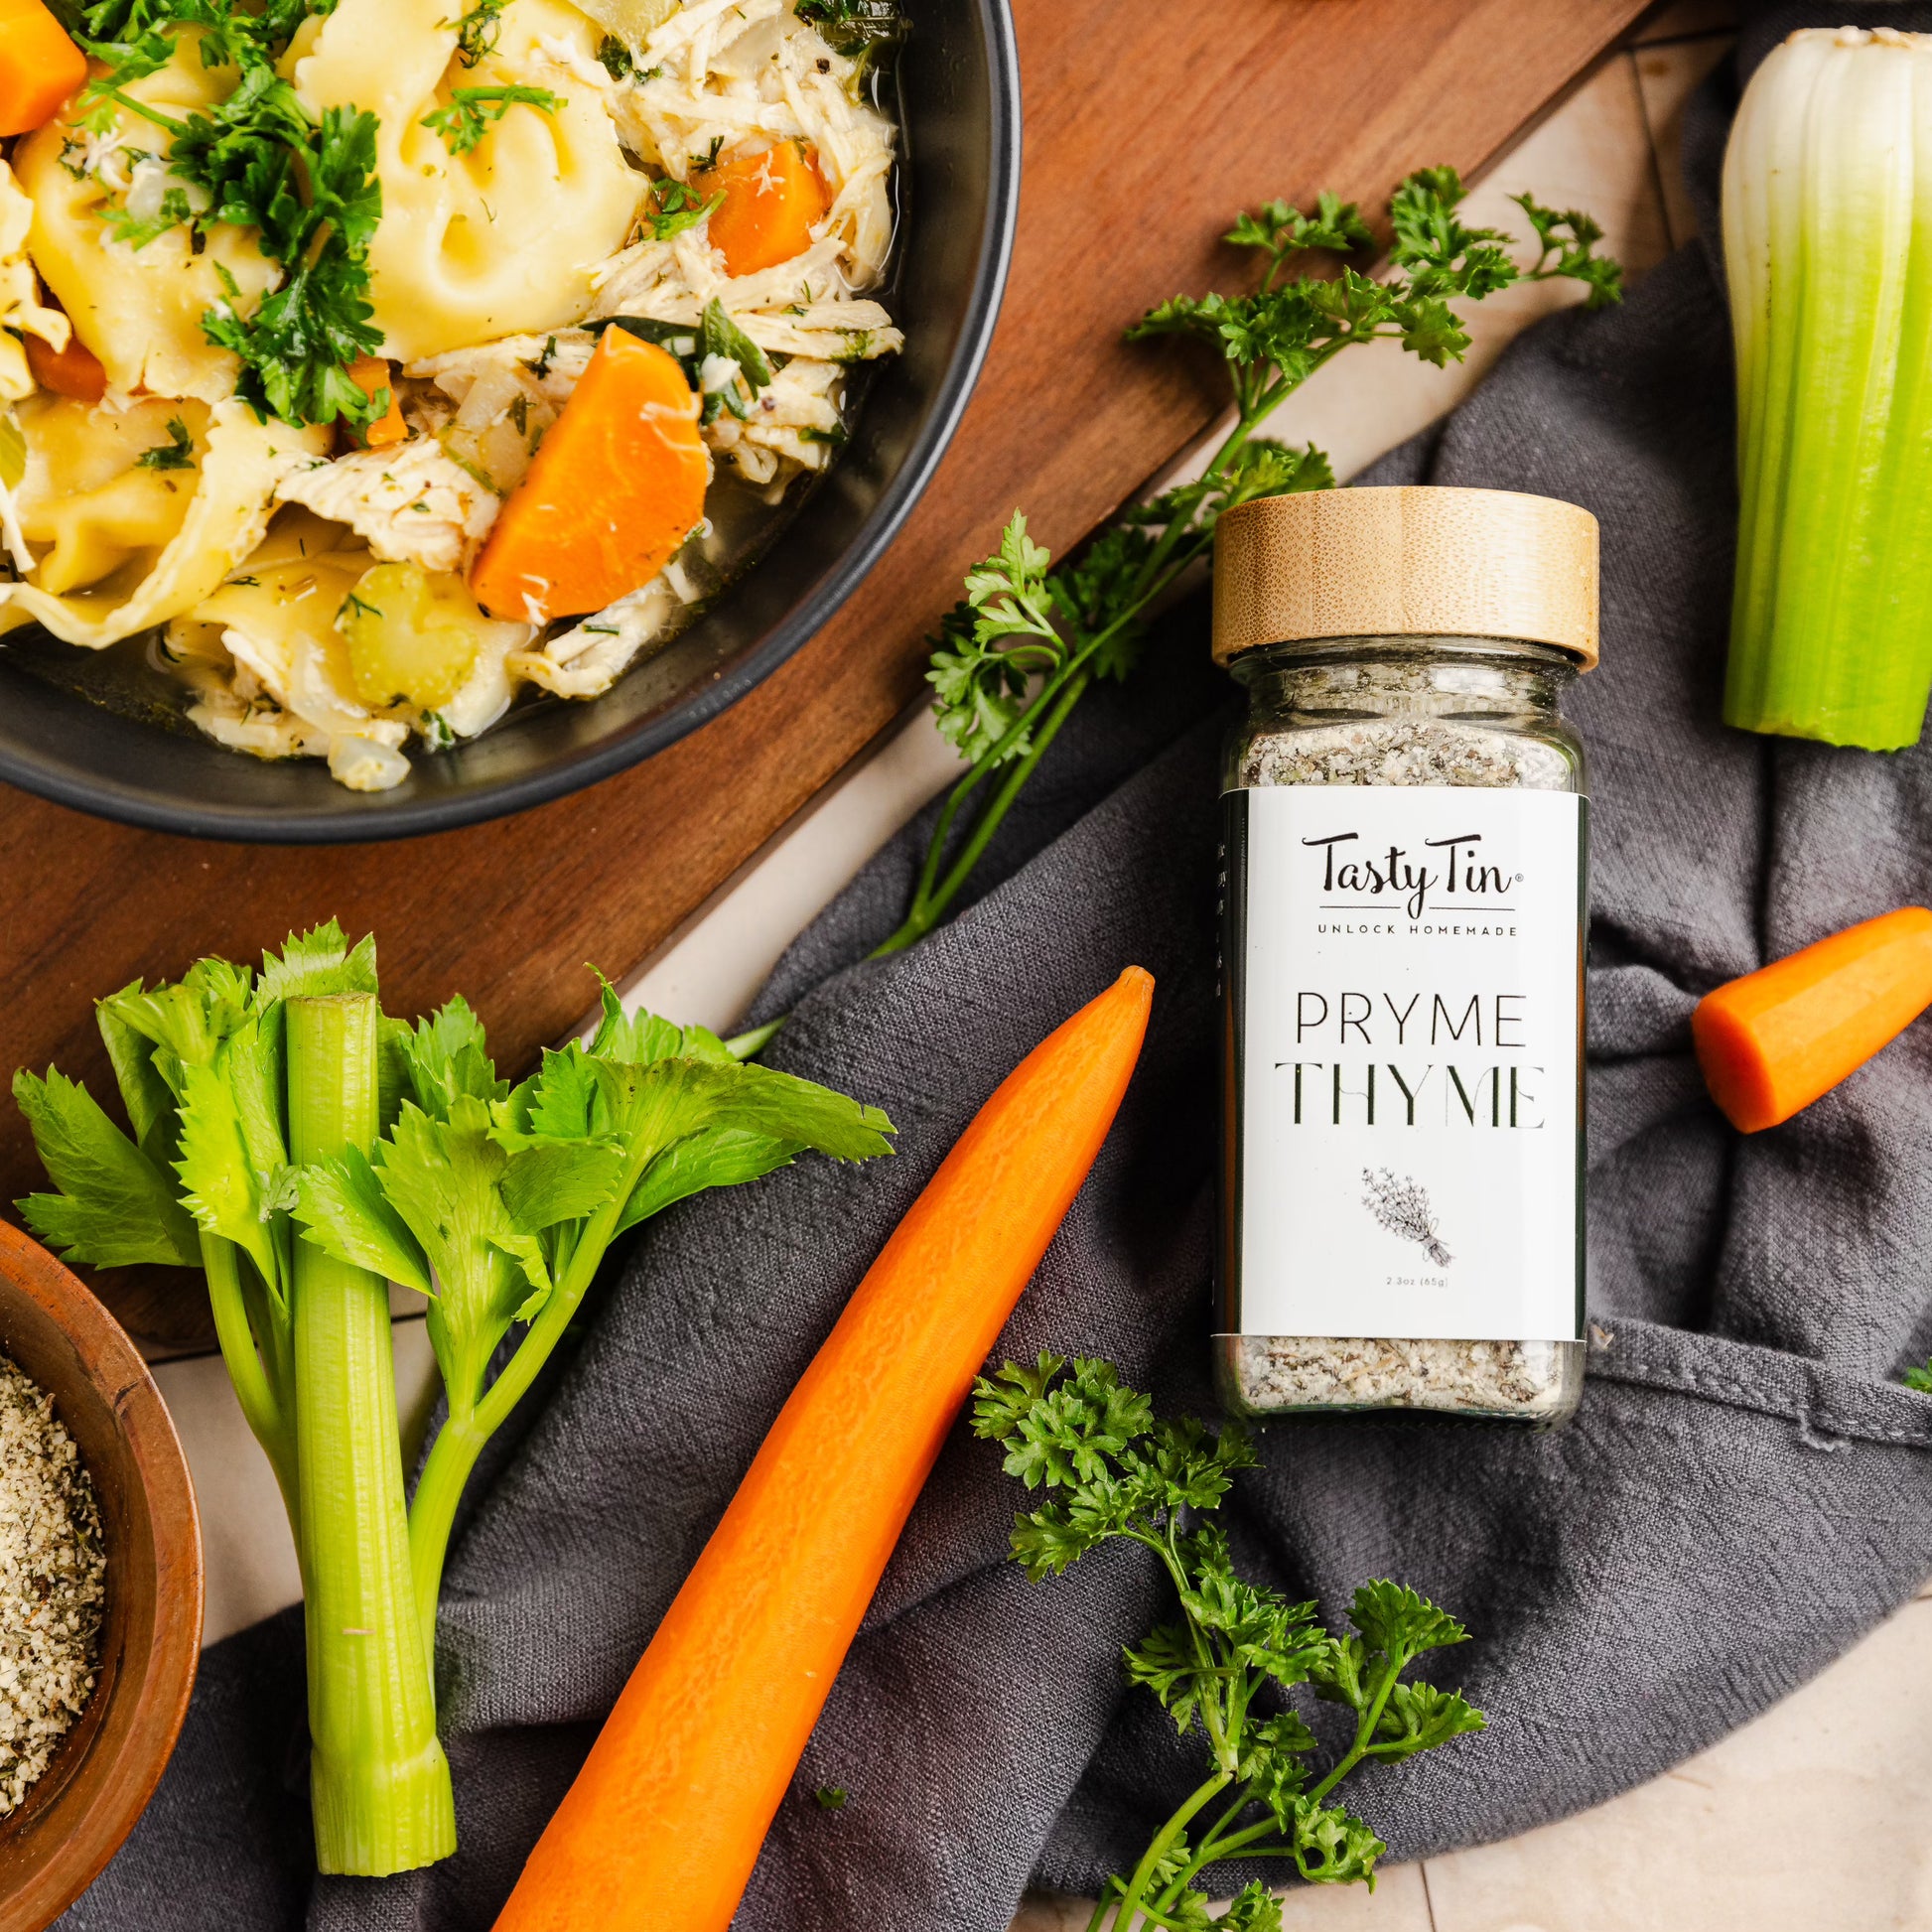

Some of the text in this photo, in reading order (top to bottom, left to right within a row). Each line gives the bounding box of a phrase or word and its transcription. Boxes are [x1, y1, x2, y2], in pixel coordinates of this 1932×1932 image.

[1302, 832, 1439, 919] Tasty
[1318, 923, 1517, 936] UNLOCK HOMEMADE
[1297, 992, 1527, 1047] PRYME
[1275, 1062, 1545, 1129] THYME
[1386, 1277, 1415, 1286] 23oz
